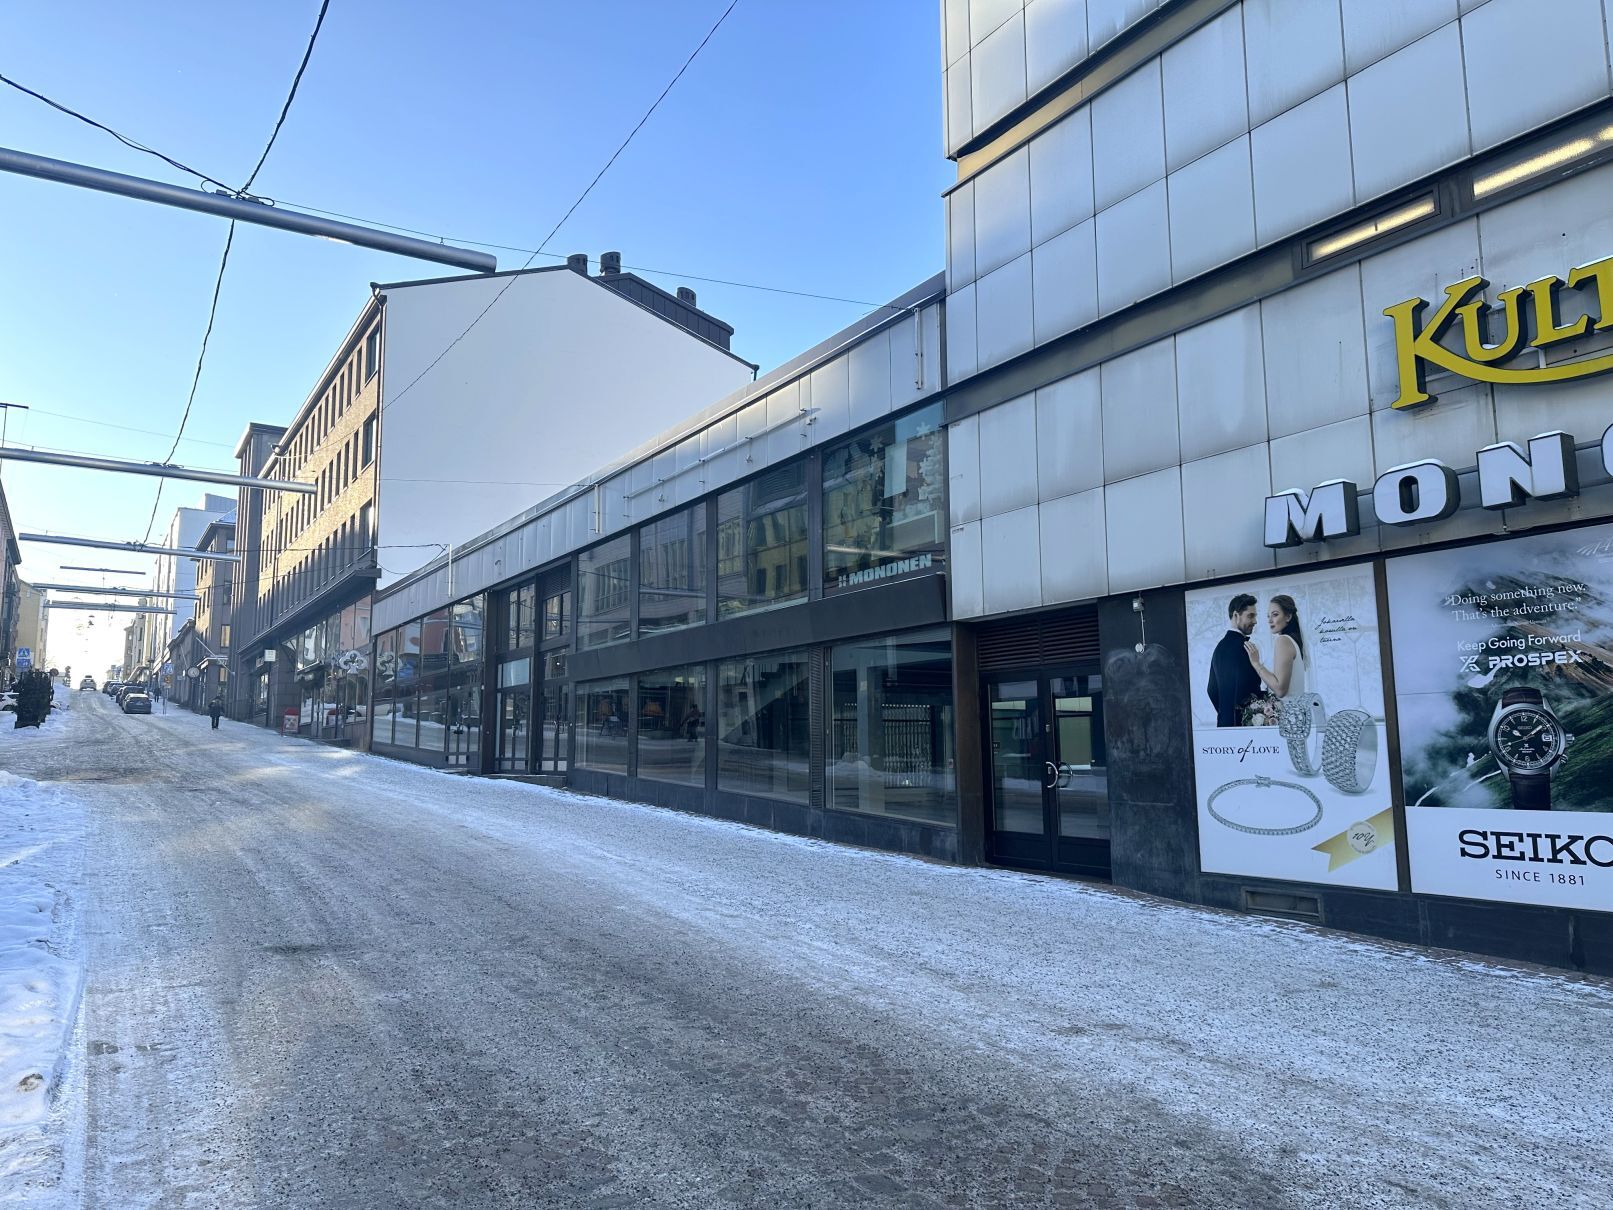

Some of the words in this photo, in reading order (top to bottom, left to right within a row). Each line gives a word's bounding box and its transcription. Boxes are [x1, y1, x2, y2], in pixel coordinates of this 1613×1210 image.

[1264, 423, 1613, 549] MON
[849, 553, 932, 586] MONONEN
[1490, 585, 1555, 601] something
[1557, 582, 1586, 594] new.
[1451, 608, 1488, 622] That's
[1490, 606, 1510, 618] the
[1457, 641, 1487, 653] Keep
[1488, 636, 1525, 650] Going
[1528, 629, 1581, 646] Forward
[1488, 650, 1583, 669] PROSPEX
[1202, 747, 1236, 755] STORY
[1237, 739, 1254, 763] of
[1252, 746, 1280, 754] LOVE
[1458, 829, 1613, 868] SEIKO
[1495, 869, 1541, 882] SINCE
[1549, 873, 1585, 886] 1881
